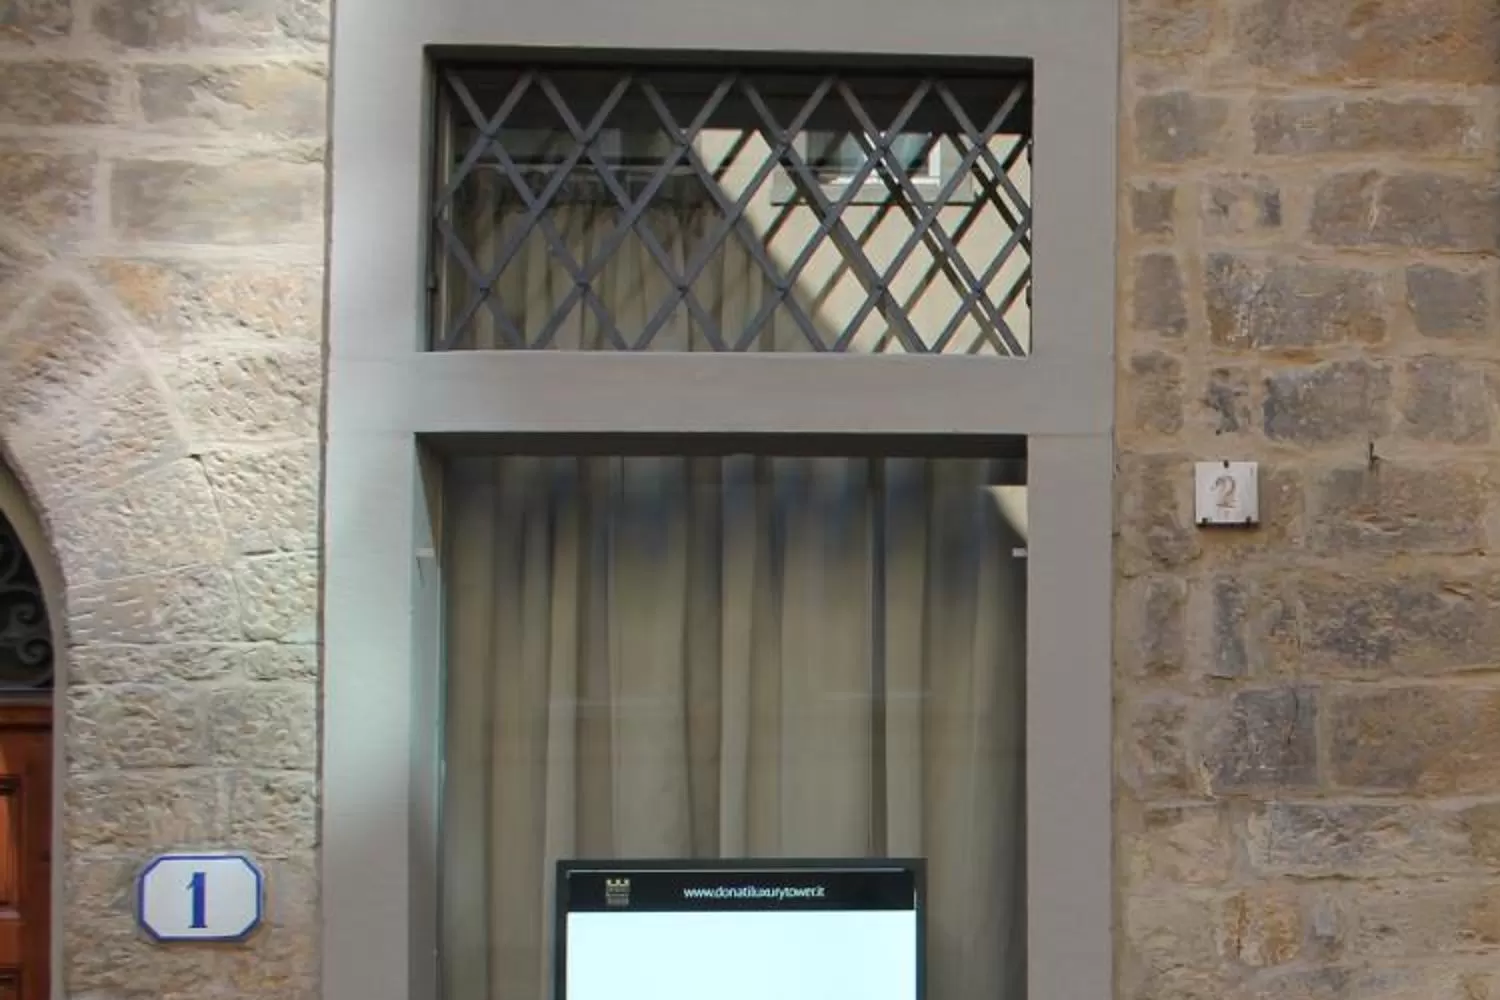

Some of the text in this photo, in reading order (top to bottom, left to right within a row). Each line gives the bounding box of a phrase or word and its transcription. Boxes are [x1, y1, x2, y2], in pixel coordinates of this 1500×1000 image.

[1210, 475, 1237, 509] 2
[185, 871, 208, 929] 1
[683, 885, 825, 900] www.donatiluxurytower.it
